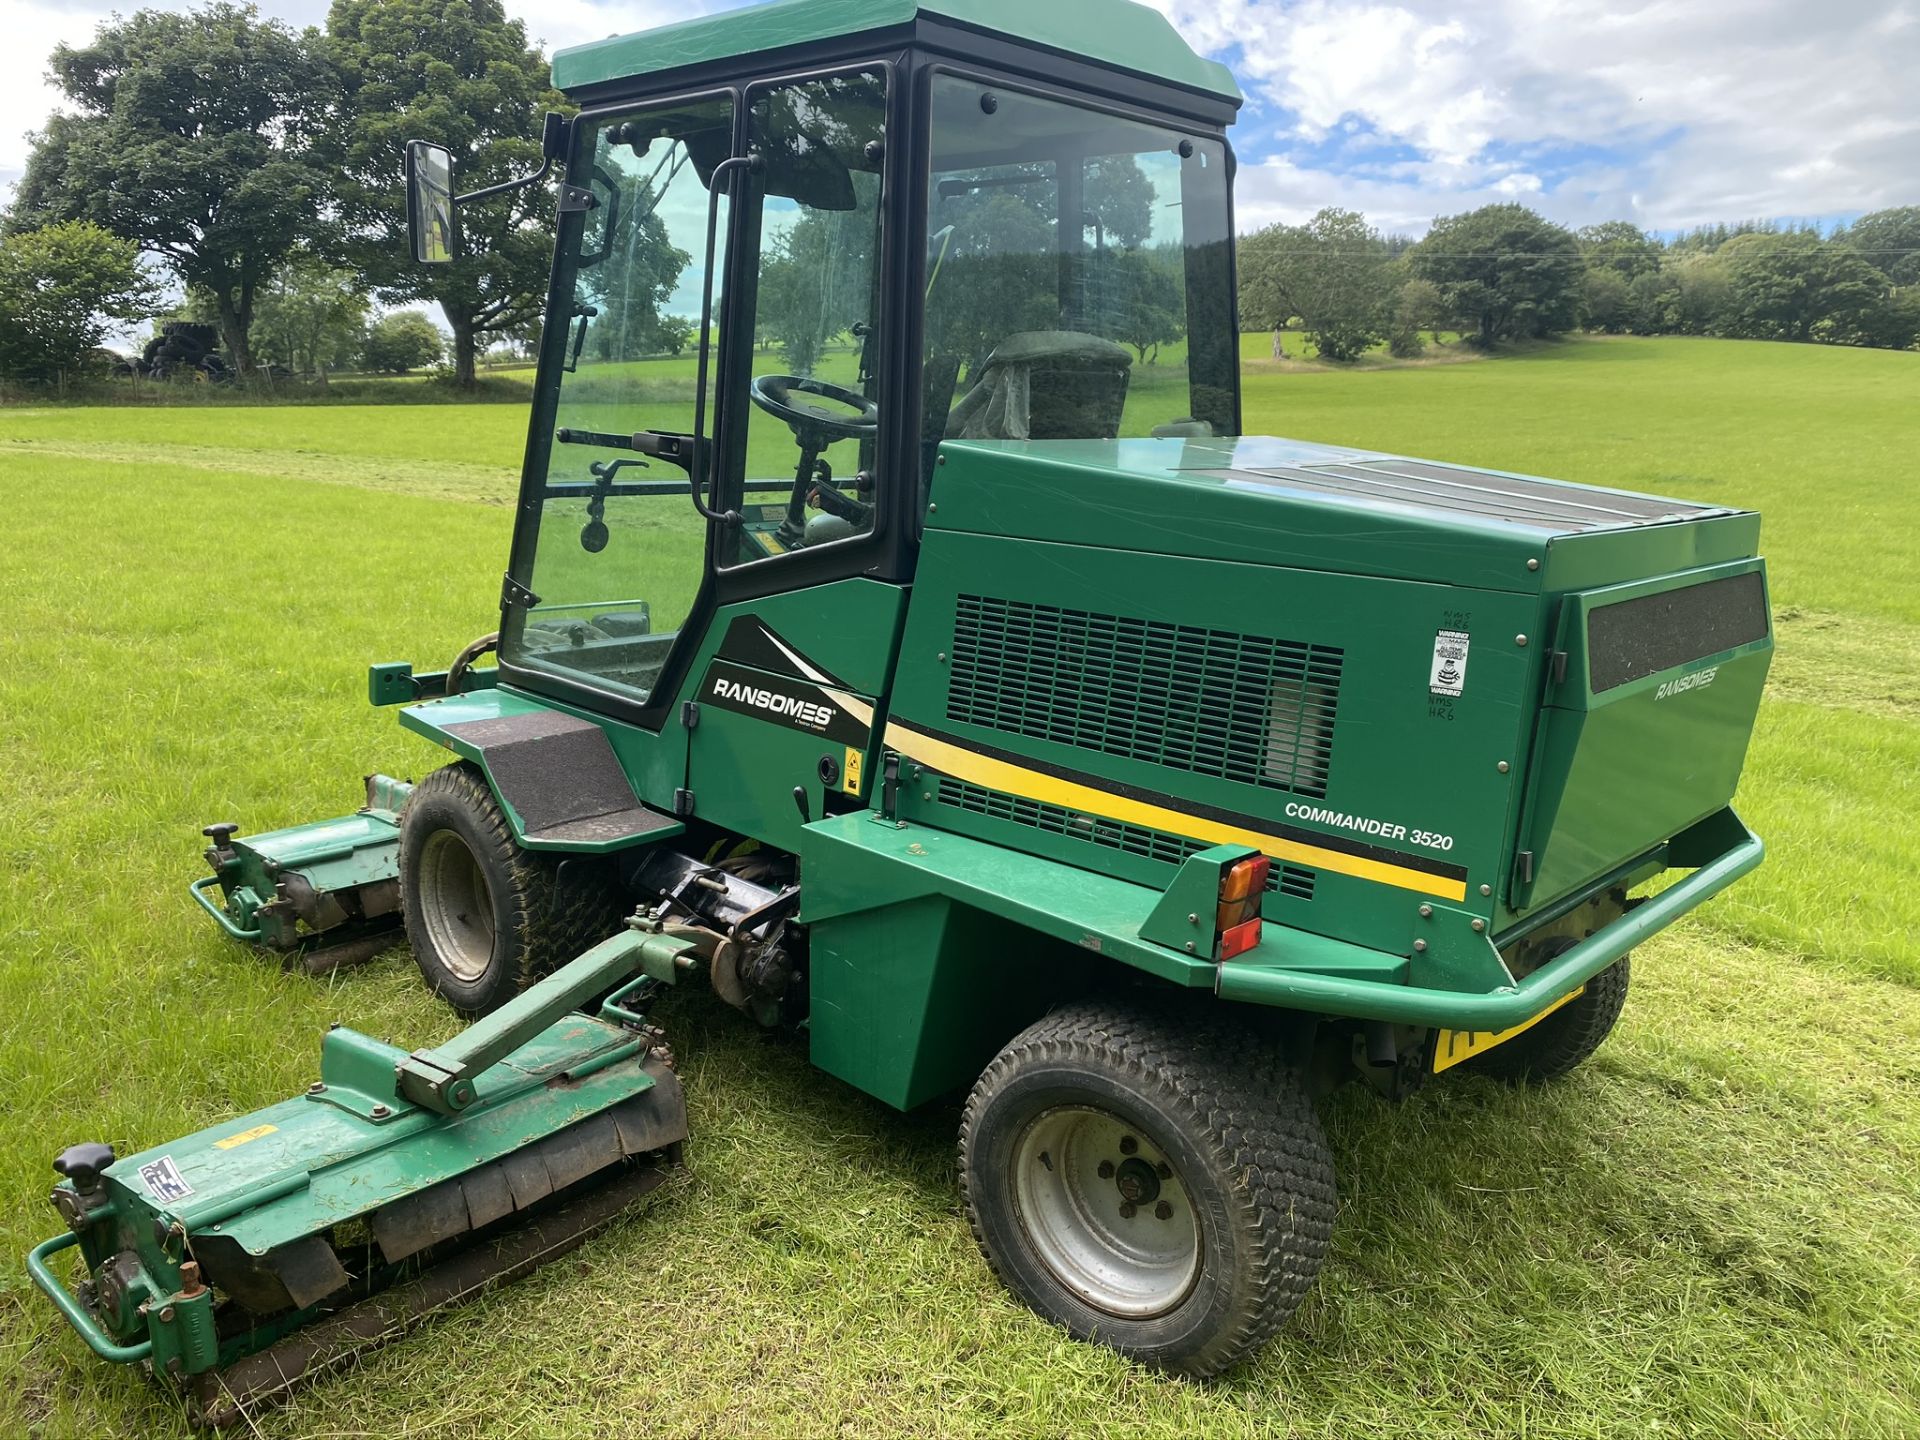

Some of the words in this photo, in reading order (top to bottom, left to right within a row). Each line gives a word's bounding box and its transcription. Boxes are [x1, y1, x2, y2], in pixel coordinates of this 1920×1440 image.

[713, 678, 832, 726] RANSOMES
[1429, 707, 1454, 720] HR6
[1285, 802, 1406, 840] COMMANDER
[1410, 829, 1453, 851] 3520
